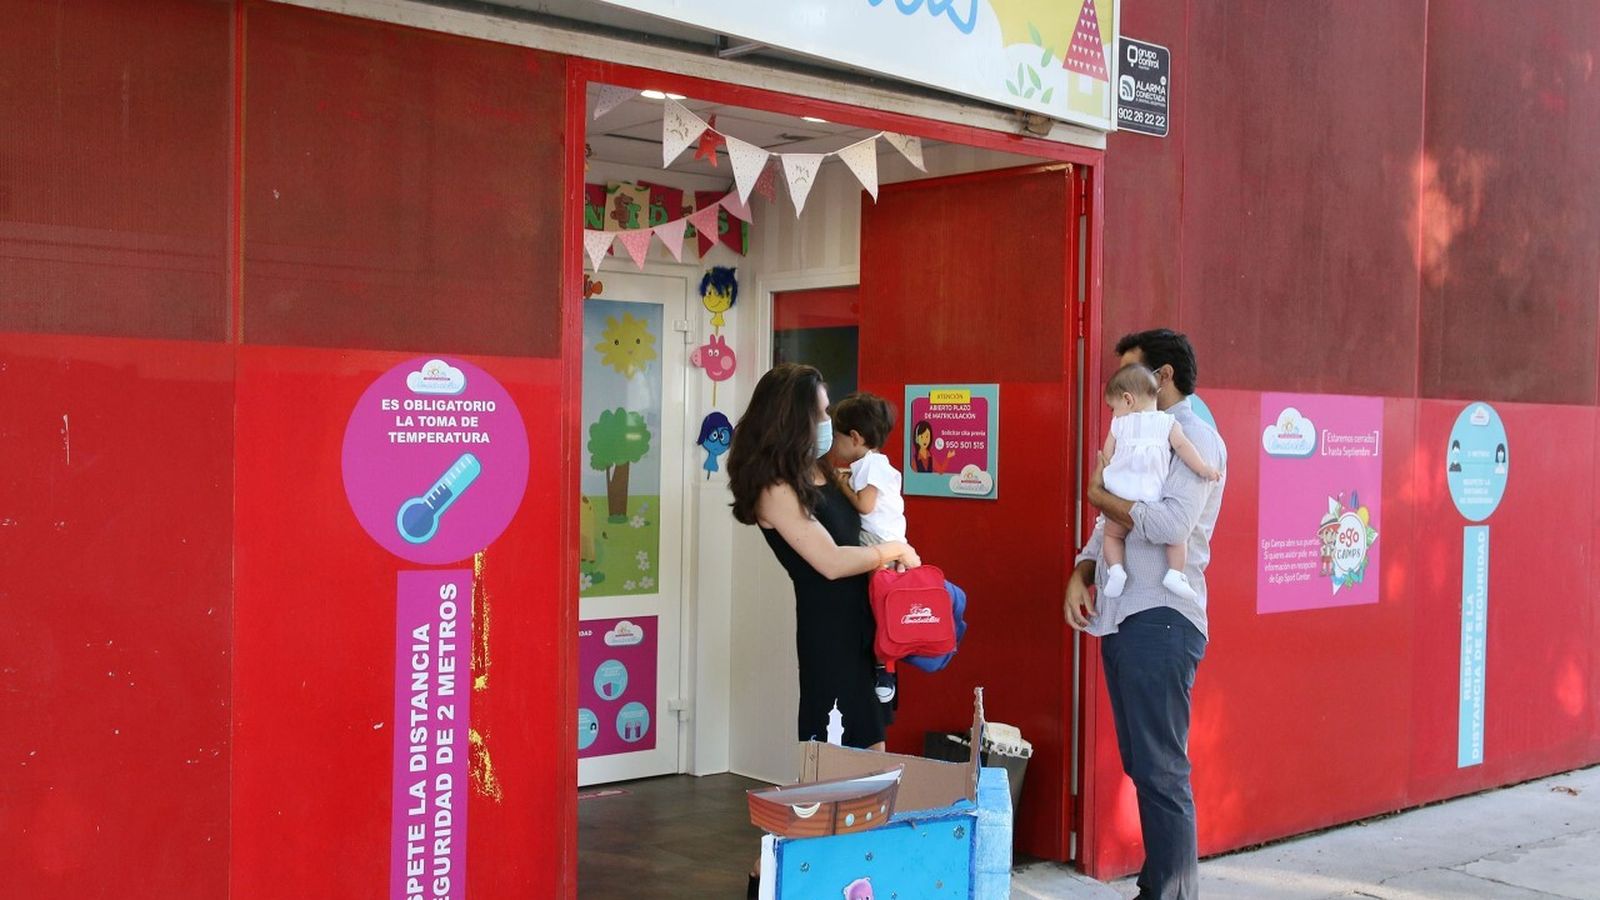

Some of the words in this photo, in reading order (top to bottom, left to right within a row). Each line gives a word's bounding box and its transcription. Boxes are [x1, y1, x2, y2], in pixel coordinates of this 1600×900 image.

[1138, 49, 1157, 60] grupo
[1138, 58, 1160, 70] control
[1136, 81, 1166, 95] ALARMA
[1118, 108, 1133, 120] 902
[1133, 111, 1144, 123] 26
[1144, 114, 1155, 125] 22
[1155, 116, 1166, 127] 22
[382, 400, 400, 411] ES
[404, 401, 496, 412] OBLIGATORIO
[396, 416, 414, 428] LA
[418, 416, 457, 428] TOMA
[461, 417, 479, 428] DE
[388, 432, 490, 444] TEMPERATURA
[945, 441, 959, 449] 950
[960, 441, 973, 449] 501
[973, 442, 985, 450] 515
[1339, 527, 1360, 547] ego
[1336, 548, 1361, 560] CAMPS
[1475, 531, 1485, 631] SEGURIDAD
[437, 583, 458, 696] METROS
[1474, 637, 1483, 660] DE
[409, 623, 430, 772] DISTANCIA
[437, 704, 454, 721] 2
[1471, 662, 1482, 760] DISTANCIA
[436, 728, 454, 765] DE
[408, 780, 427, 816] LA
